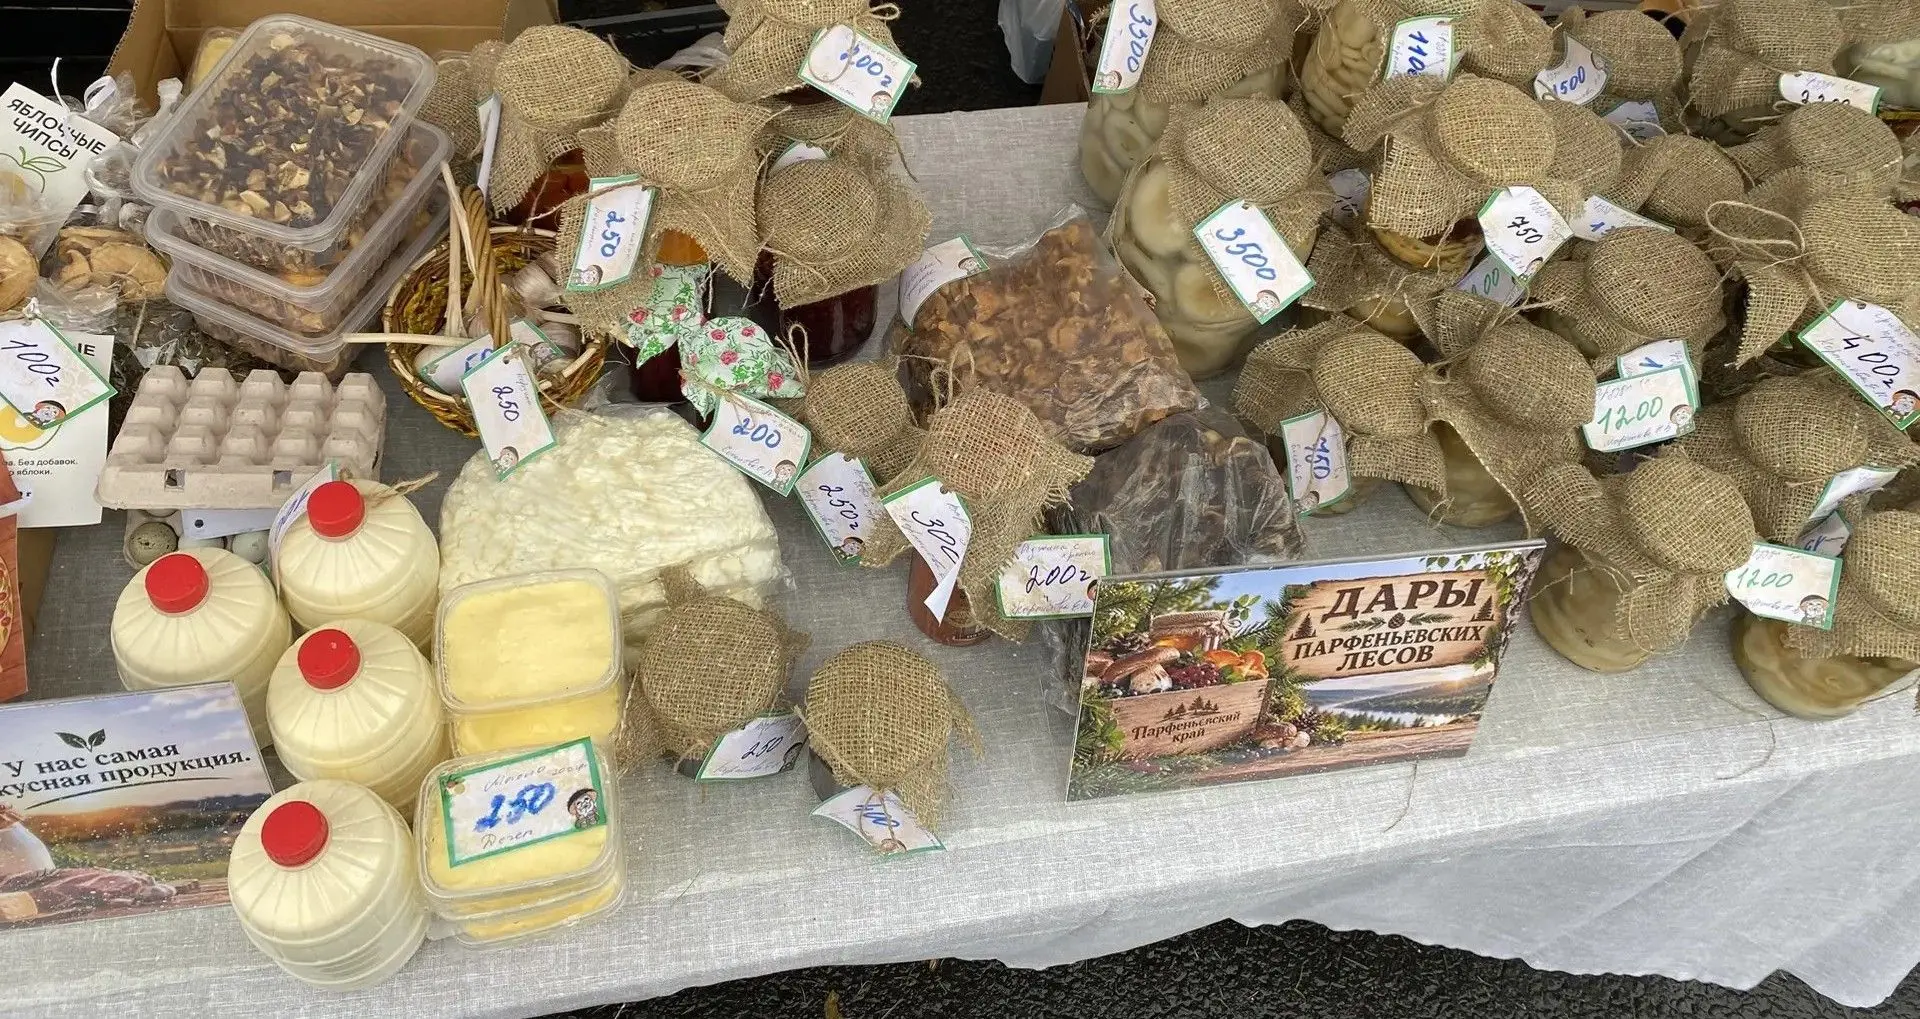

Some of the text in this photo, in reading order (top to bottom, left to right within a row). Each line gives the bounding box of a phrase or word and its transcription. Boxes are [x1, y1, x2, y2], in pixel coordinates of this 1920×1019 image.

[1127, 3, 1153, 73] 3500
[1553, 65, 1586, 94] 1500
[13, 117, 79, 160] ЧИПСЫ
[600, 210, 626, 258] 250
[1507, 215, 1544, 244] 750
[1215, 227, 1277, 281] 3500
[491, 385, 520, 422] 250
[1597, 396, 1664, 435] 1200
[732, 417, 782, 449] 200
[17, 468, 53, 476] яблоки.
[18, 458, 35, 466] Без
[37, 457, 79, 466] добавок.
[1737, 567, 1794, 589] 1200
[1320, 578, 1486, 624] ДАРЫ
[1292, 625, 1485, 661] ПАРФЕНЬЕВСКИХ
[1336, 645, 1435, 672] ЛЕСОВ
[1131, 711, 1241, 741] Парфеньевский
[1172, 728, 1205, 743] край
[1, 743, 180, 777] У нас самая
[741, 736, 784, 760] 250
[100, 750, 252, 784] продукция.
[473, 782, 557, 833] 250
